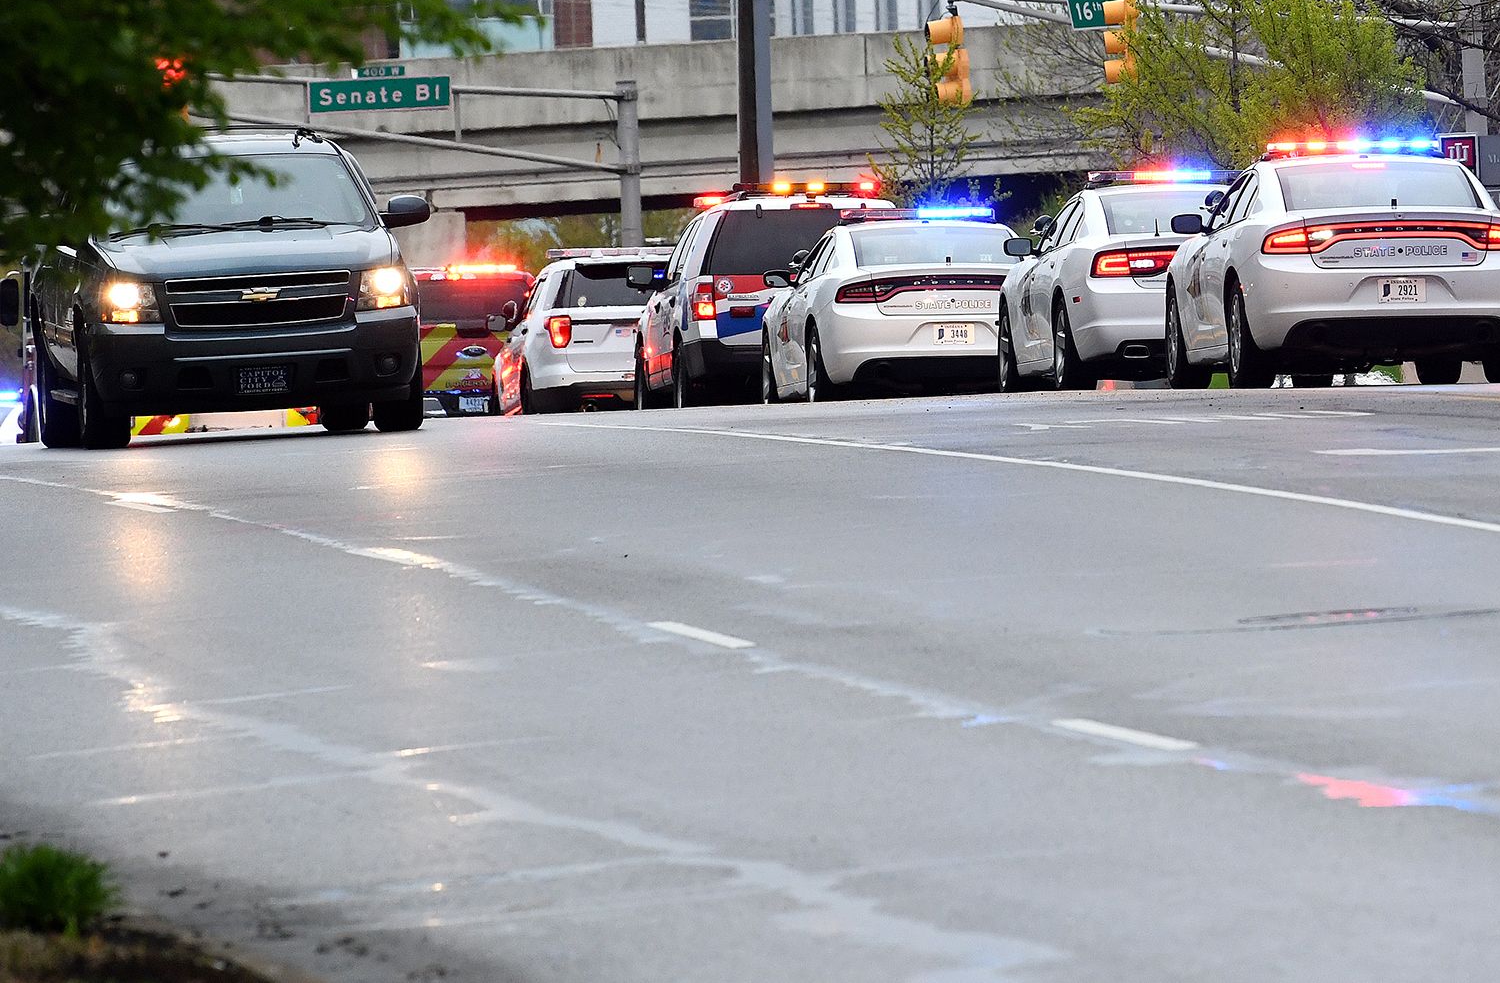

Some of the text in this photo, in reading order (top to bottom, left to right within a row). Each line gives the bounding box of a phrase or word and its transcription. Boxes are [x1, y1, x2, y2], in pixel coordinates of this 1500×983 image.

[1075, 1, 1102, 20] 16th
[363, 66, 400, 77] 400 W
[319, 84, 440, 106] Senate Bl
[1353, 245, 1448, 258] STATE POLICE
[1398, 284, 1418, 296] 2921
[914, 300, 951, 309] STATE
[954, 299, 992, 309] POLICE
[950, 329, 968, 339] 3448
